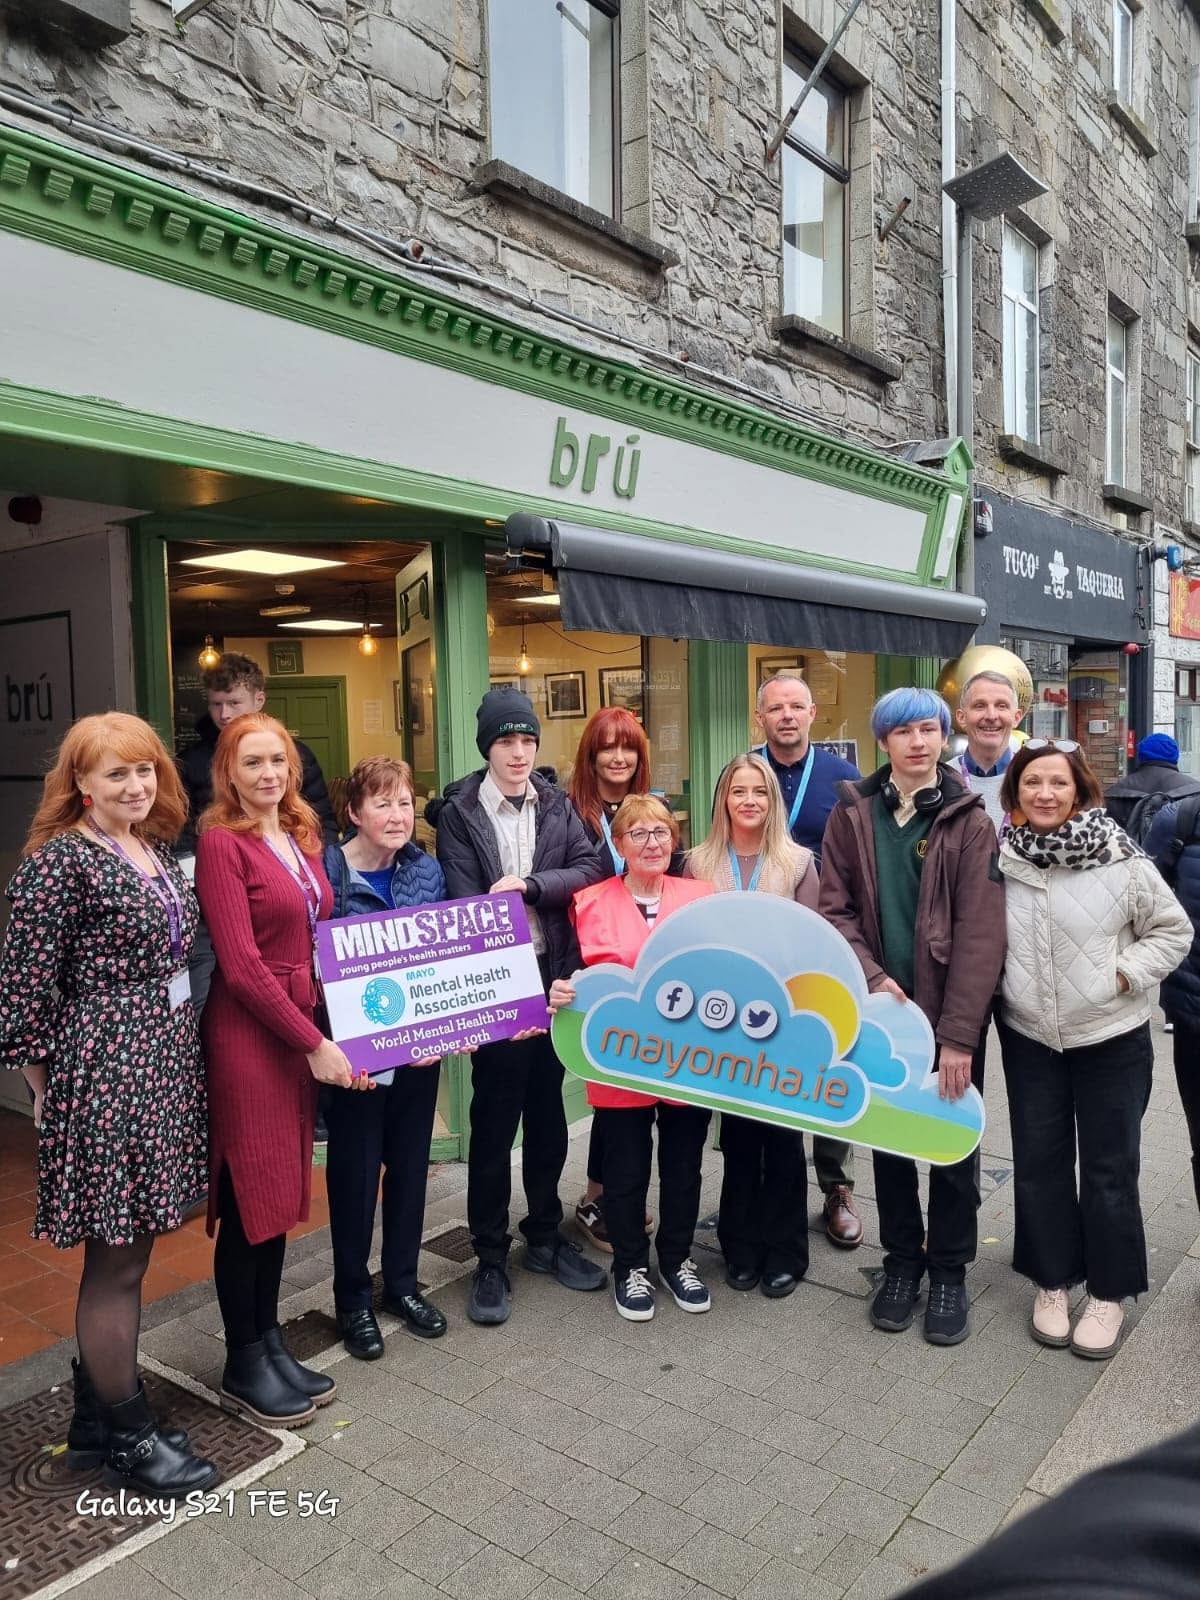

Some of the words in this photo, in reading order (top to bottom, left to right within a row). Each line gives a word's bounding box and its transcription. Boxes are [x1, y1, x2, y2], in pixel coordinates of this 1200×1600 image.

[549, 416, 641, 500] brú
[1077, 564, 1125, 600] TAQUERIA
[6, 672, 53, 722] brú
[483, 933, 516, 949] MAYO
[339, 962, 370, 977] young
[370, 953, 409, 972] people's
[408, 947, 436, 962] health
[436, 943, 472, 957] matters
[406, 967, 436, 981] MAYO
[409, 976, 462, 1000] Mental
[464, 966, 511, 988] Health
[414, 987, 497, 1017] Association
[371, 1034, 411, 1052] World
[411, 1024, 455, 1044] Mental
[455, 1013, 496, 1032] Health
[495, 1007, 519, 1026] Day
[410, 1039, 462, 1060] October
[462, 1030, 491, 1048] 10th
[600, 1026, 850, 1109] mayomha.ie
